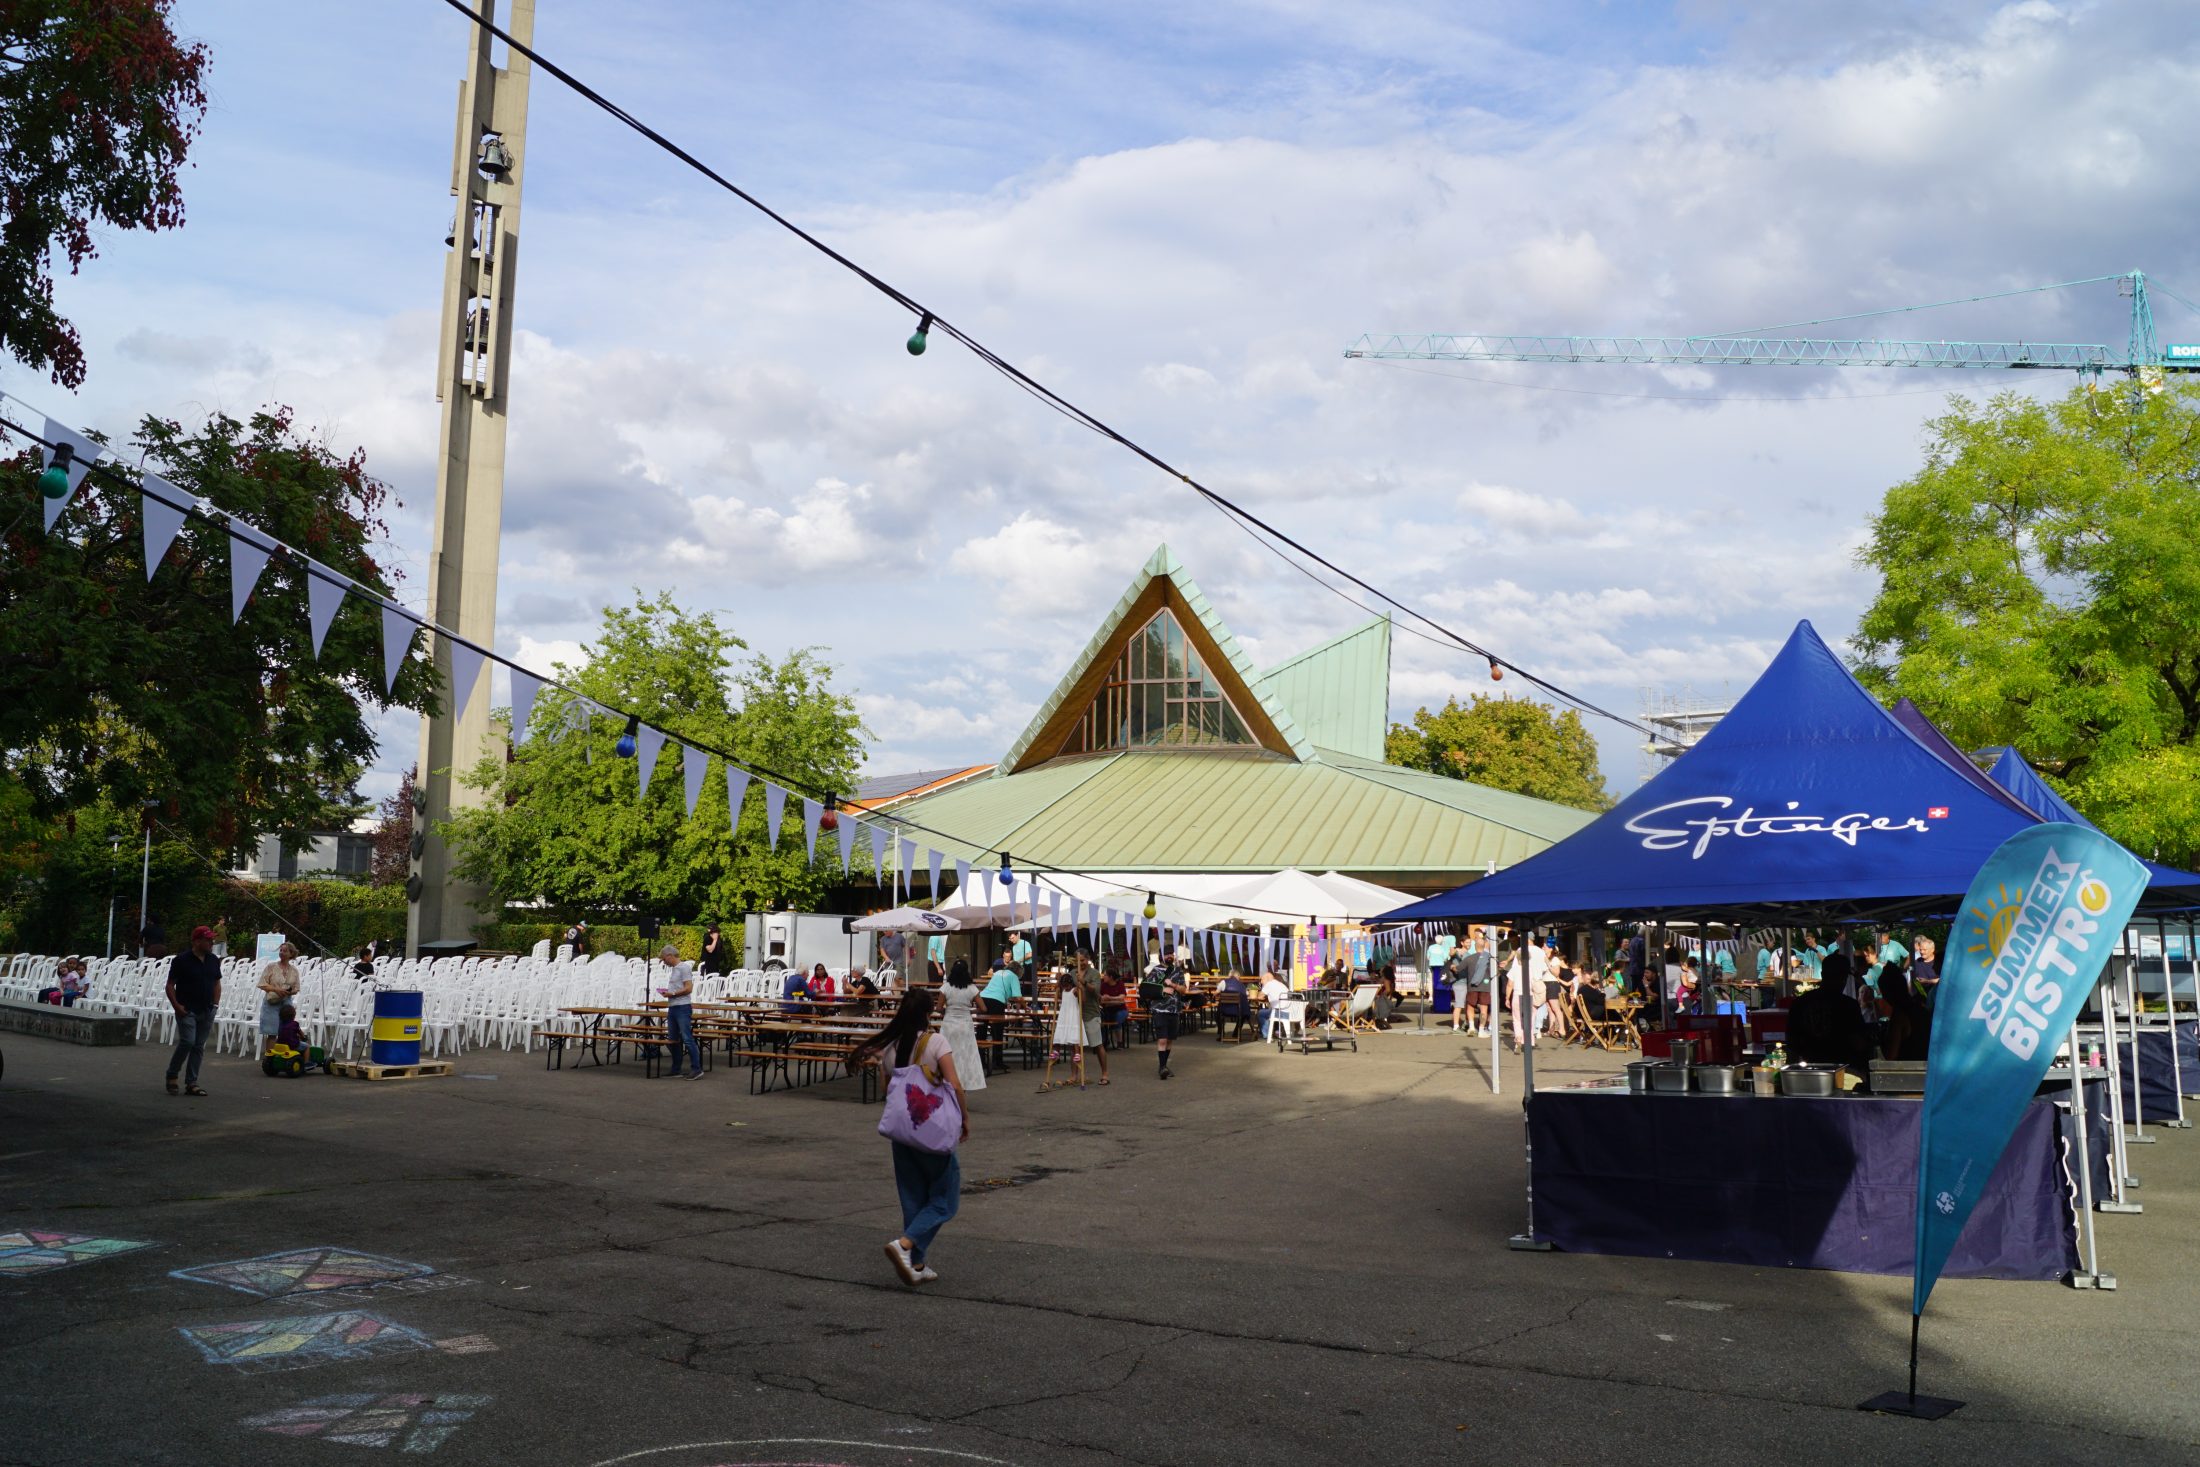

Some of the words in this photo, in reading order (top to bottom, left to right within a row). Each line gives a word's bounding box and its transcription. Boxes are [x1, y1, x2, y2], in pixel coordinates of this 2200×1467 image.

[2172, 345, 2200, 357] ROF
[1624, 796, 1930, 860] Eptinger
[1980, 862, 2071, 1022] SUMMER
[2000, 869, 2112, 1061] BISTRO
